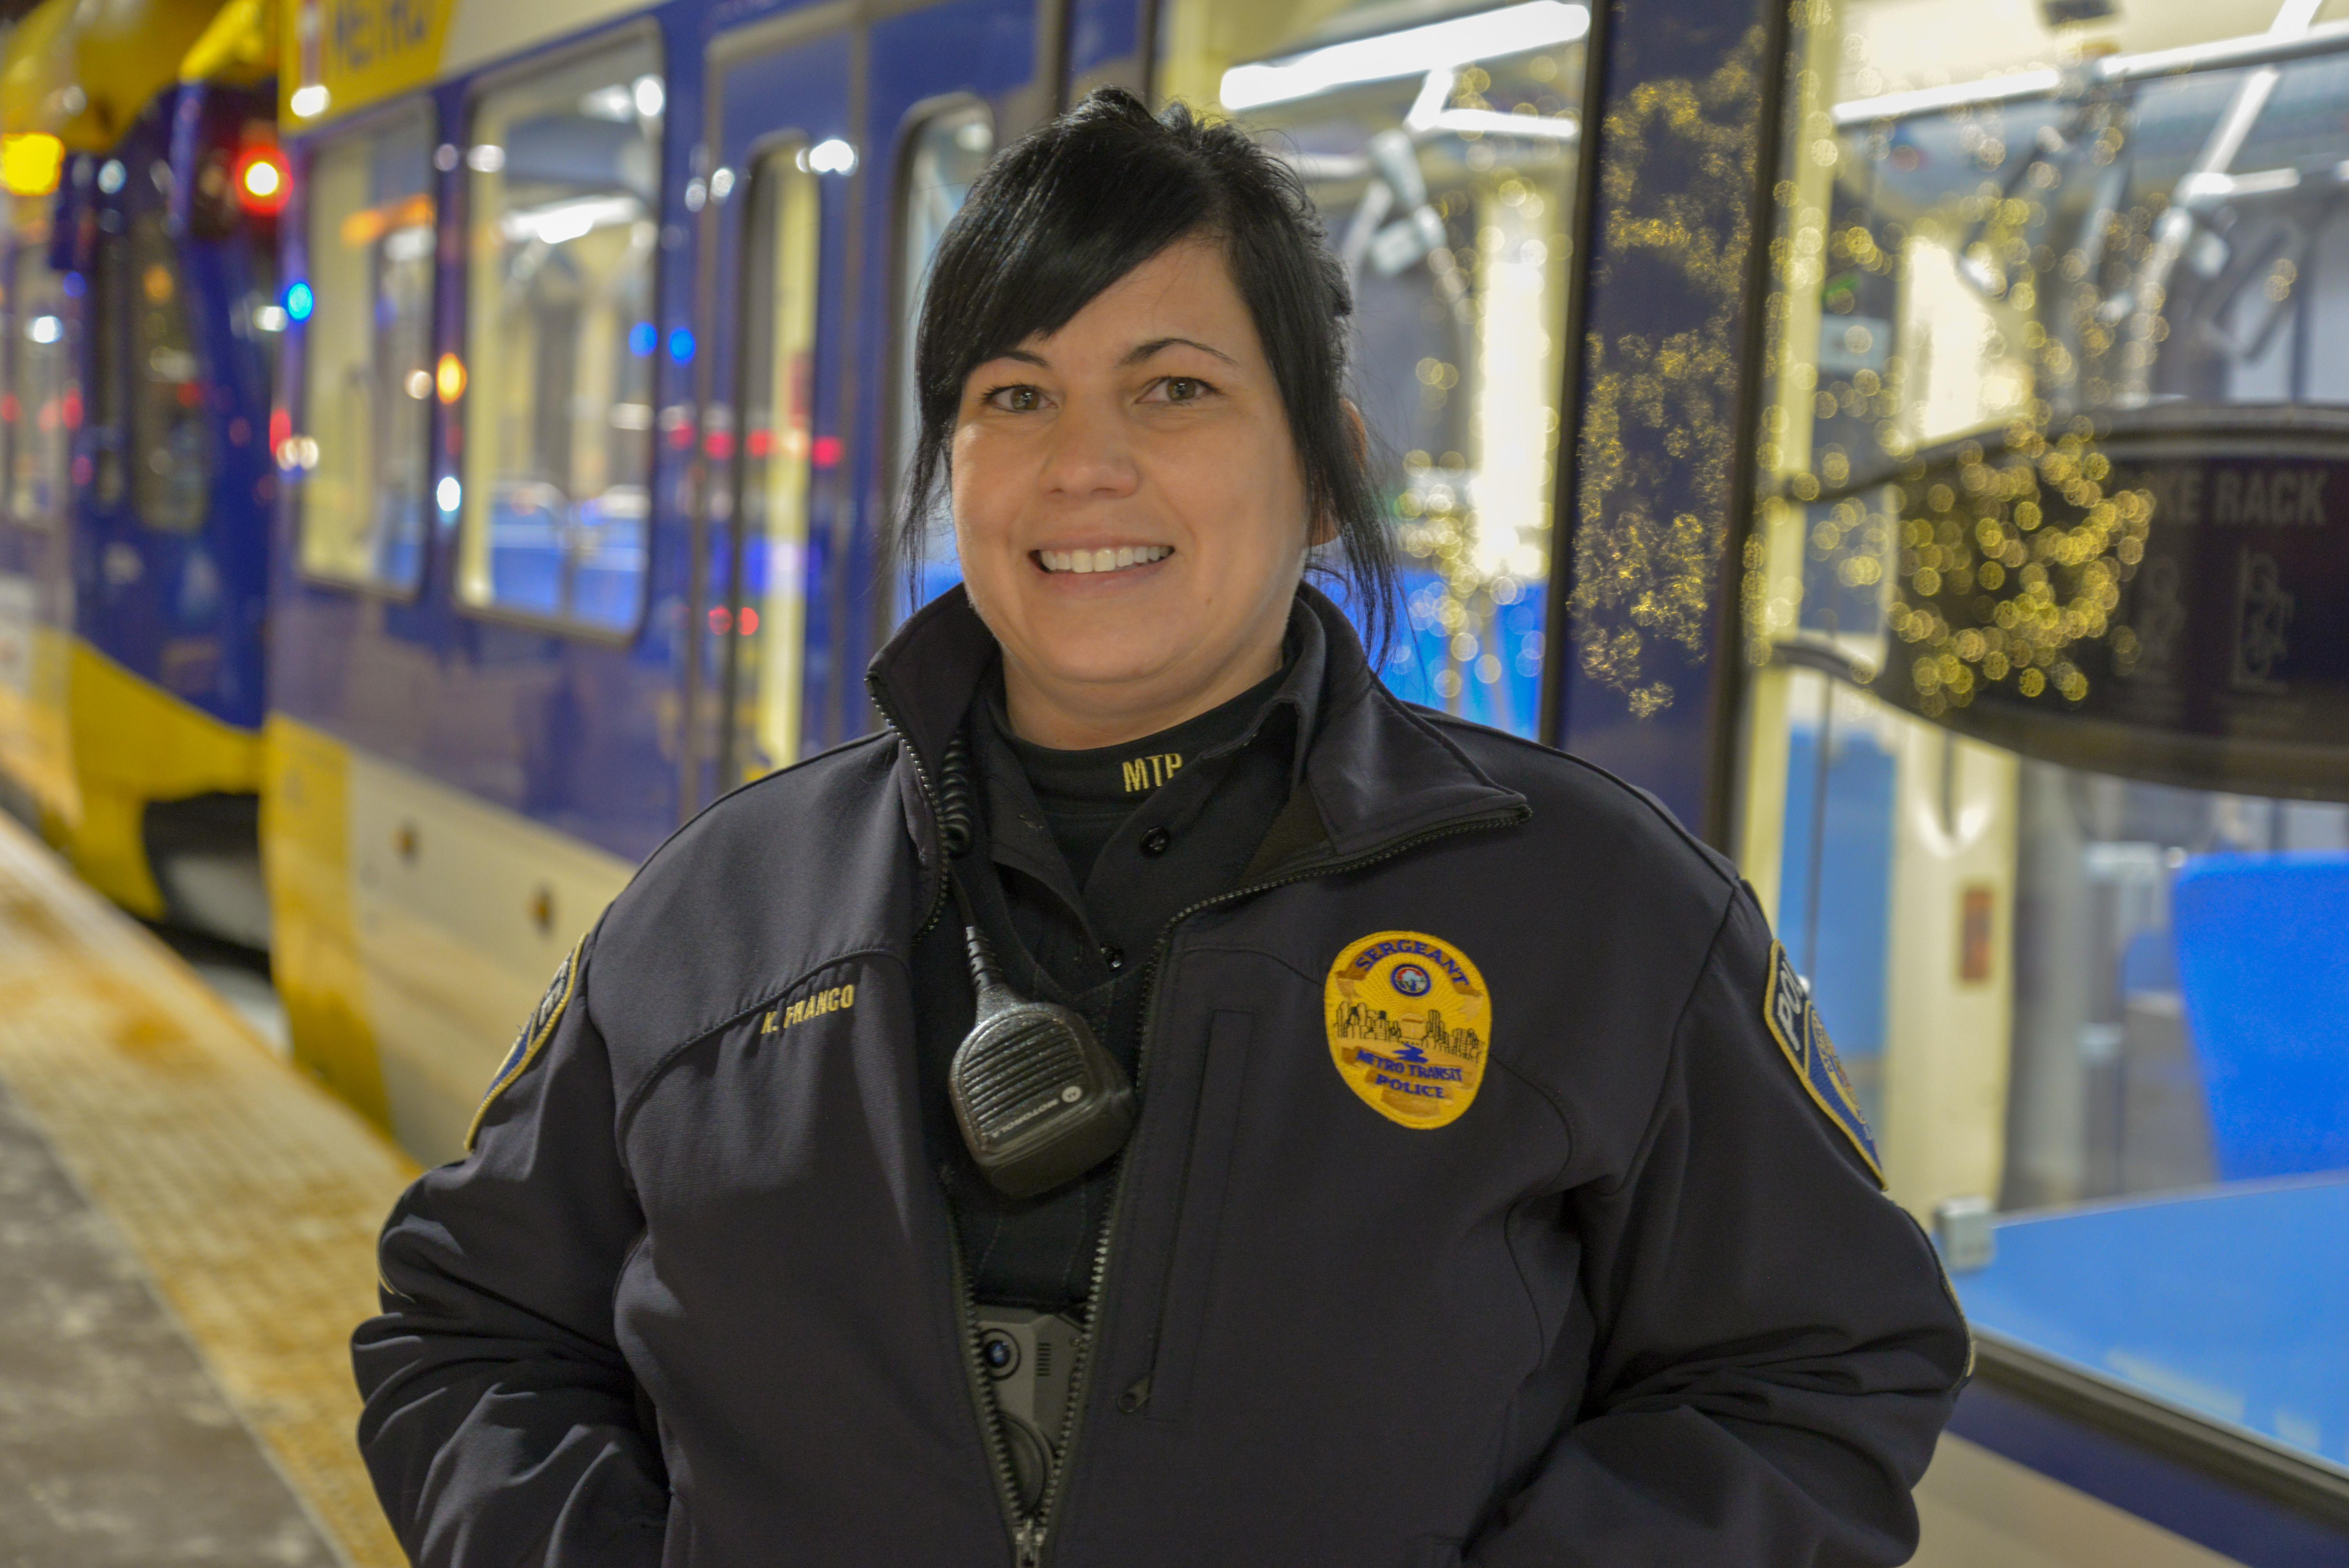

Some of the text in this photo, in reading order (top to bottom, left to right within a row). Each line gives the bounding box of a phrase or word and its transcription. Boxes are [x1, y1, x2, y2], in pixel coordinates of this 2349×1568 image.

[2211, 467, 2330, 526] RACK
[1122, 753, 1183, 792] MTP
[1356, 939, 1470, 987] SERGEANT
[783, 984, 854, 1028] FRANCO
[1777, 957, 1803, 1051] POL
[1356, 1049, 1463, 1081] METRO TRANSIT
[1375, 1073, 1445, 1098] POLICE
